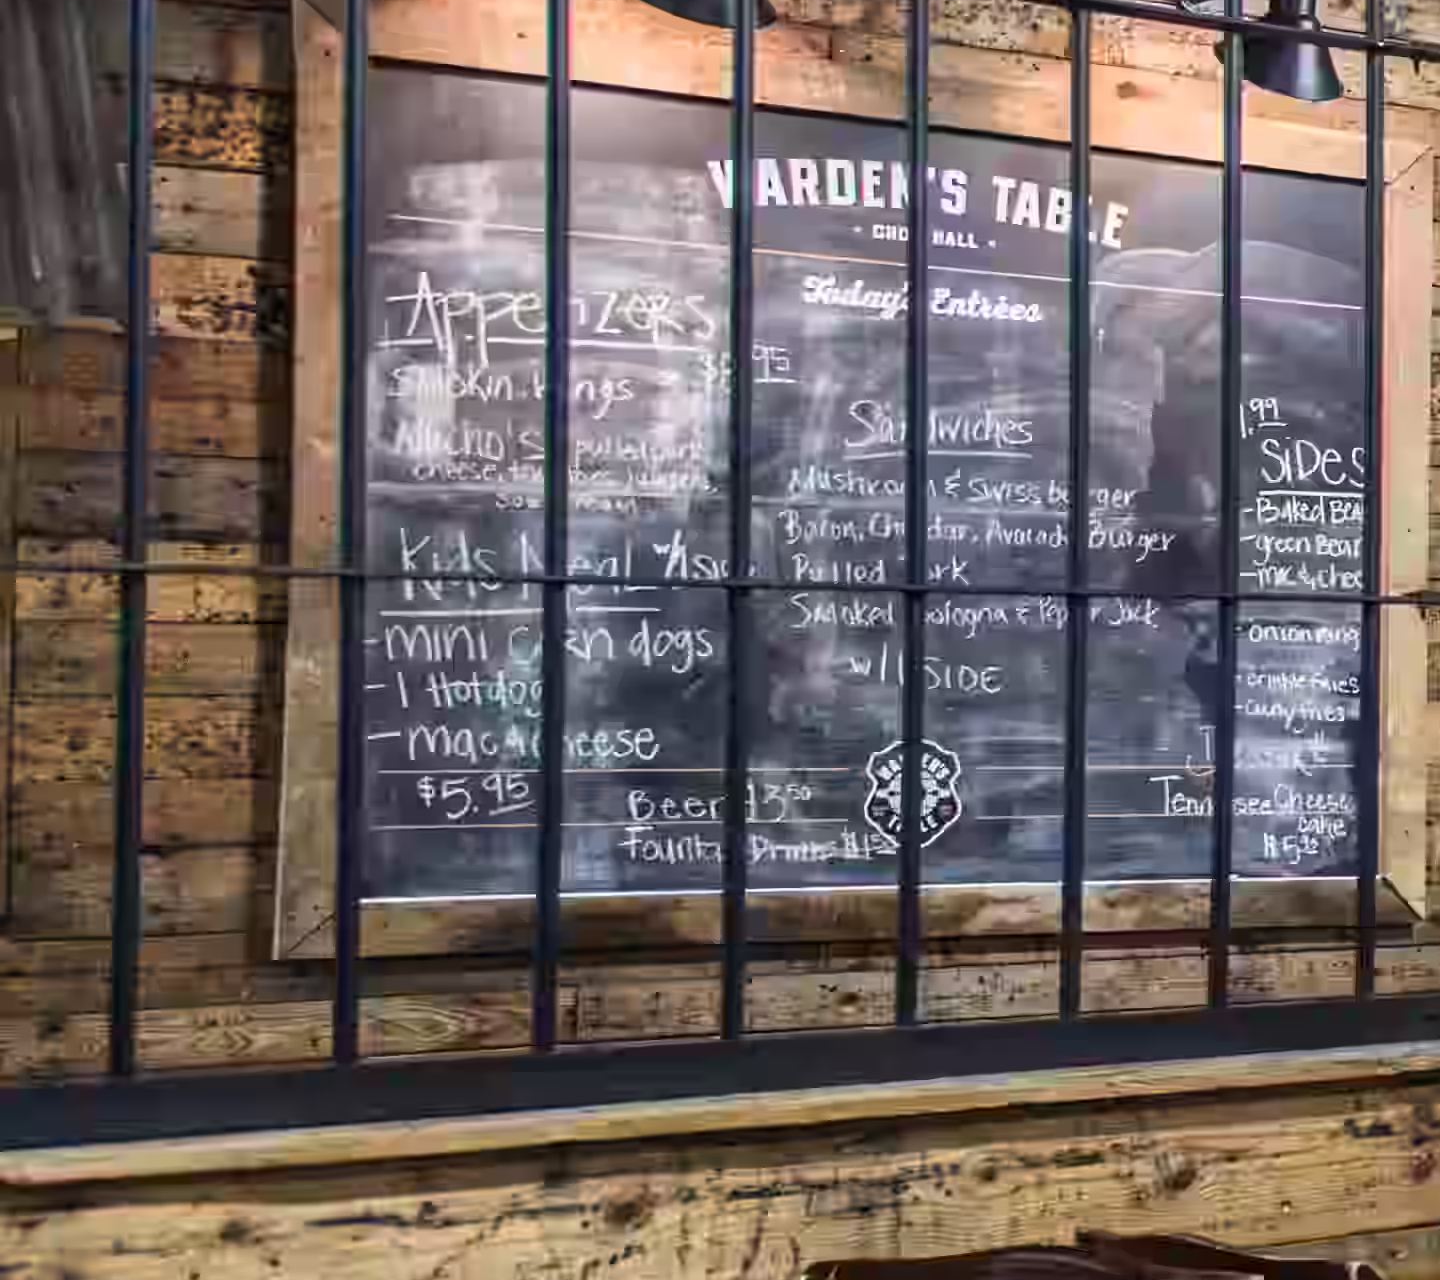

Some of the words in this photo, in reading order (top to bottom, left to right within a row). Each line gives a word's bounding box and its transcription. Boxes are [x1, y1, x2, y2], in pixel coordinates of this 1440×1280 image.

[872, 223, 924, 241] CHO
[932, 232, 980, 250] HALL
[533, 370, 635, 420] ngs
[787, 464, 937, 498] Mushro
[922, 598, 1008, 639] ologna
[1040, 595, 1101, 631] Pepr
[629, 617, 713, 673] dogs
[627, 790, 727, 822] Beer
[620, 827, 733, 865] Founta
